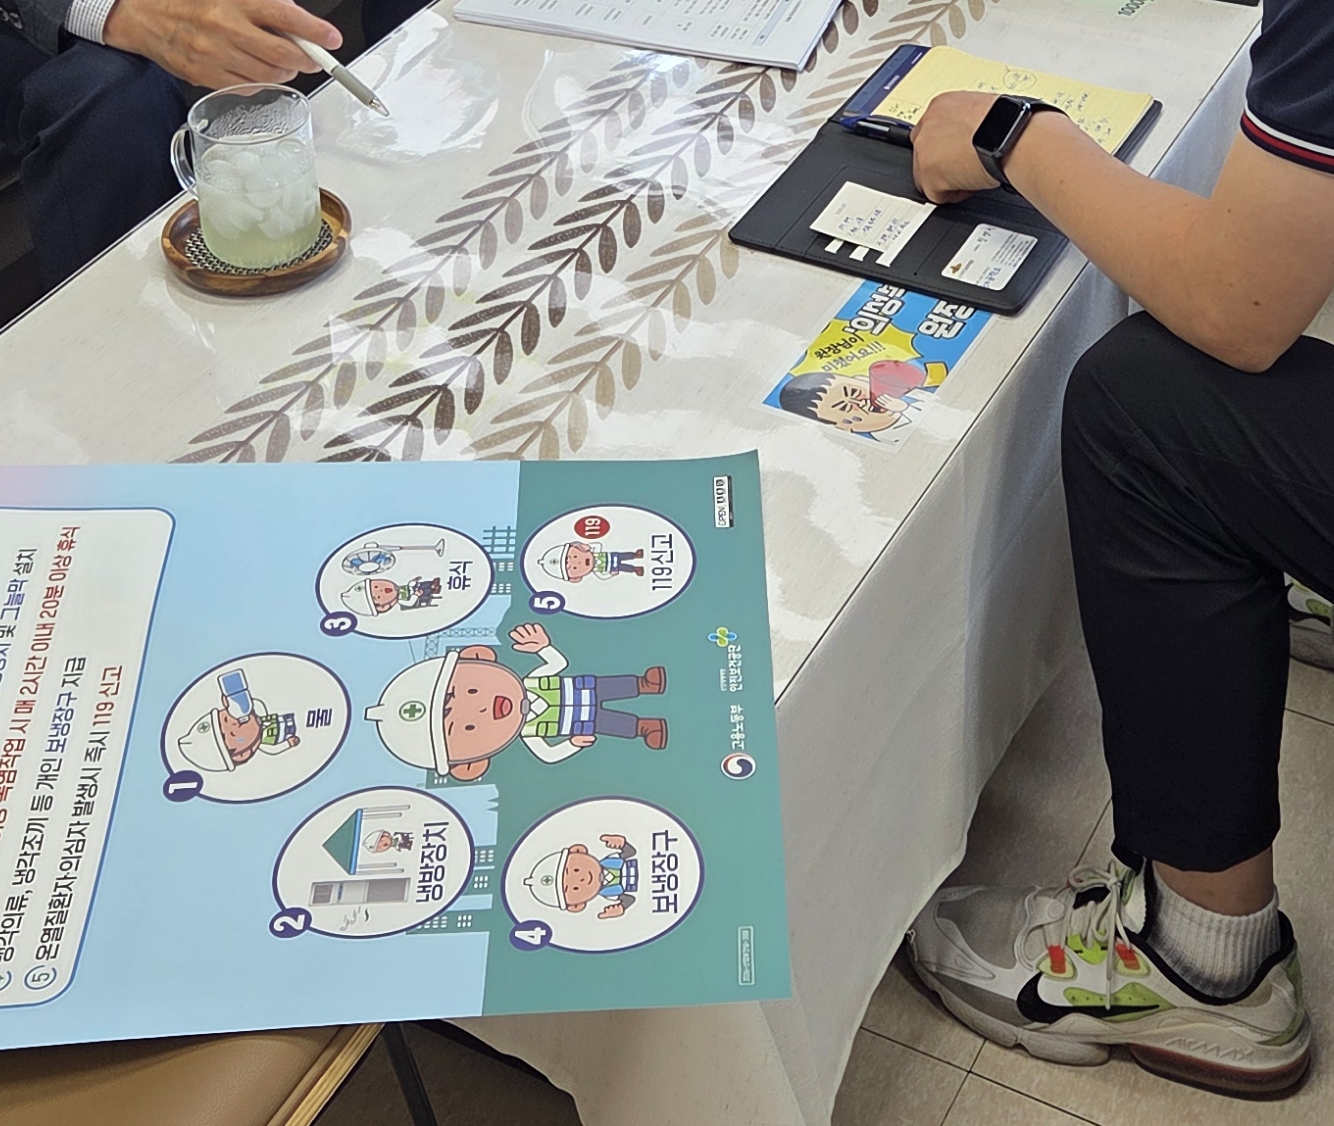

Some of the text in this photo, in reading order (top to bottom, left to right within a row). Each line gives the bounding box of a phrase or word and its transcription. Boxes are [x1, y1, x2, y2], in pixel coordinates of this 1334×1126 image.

[814, 332, 865, 360] 원장님이
[56, 526, 81, 552] 휴식
[584, 517, 601, 536] 119
[12, 548, 38, 575] 설치
[48, 554, 72, 582] 이상
[446, 560, 474, 591] 휴식
[651, 533, 674, 591] 119신고
[0, 578, 29, 620] 그늘막
[39, 585, 65, 619] 20분
[533, 596, 561, 610] 5
[30, 622, 56, 652] 이내
[324, 616, 352, 631] 3
[19, 656, 48, 695] 2시간
[61, 657, 86, 688] 지급
[99, 665, 123, 696] 신고
[727, 644, 743, 692] 안전보건공단
[13, 699, 37, 715] 매
[44, 691, 78, 753] 보냉장구
[92, 701, 114, 727] 119
[305, 708, 333, 729] 물
[9, 718, 31, 734] 시
[730, 704, 745, 751] 고용노동부
[84, 730, 110, 762] 즉시
[36, 758, 63, 790] 개인
[168, 781, 199, 794] 1
[30, 794, 53, 812] 등
[71, 767, 102, 816] 발생시
[11, 817, 49, 885] 냉각조끼
[415, 821, 450, 903] 냉방장치
[651, 829, 679, 914] 보냉장구
[273, 913, 306, 932] 2
[514, 927, 547, 946] 4
